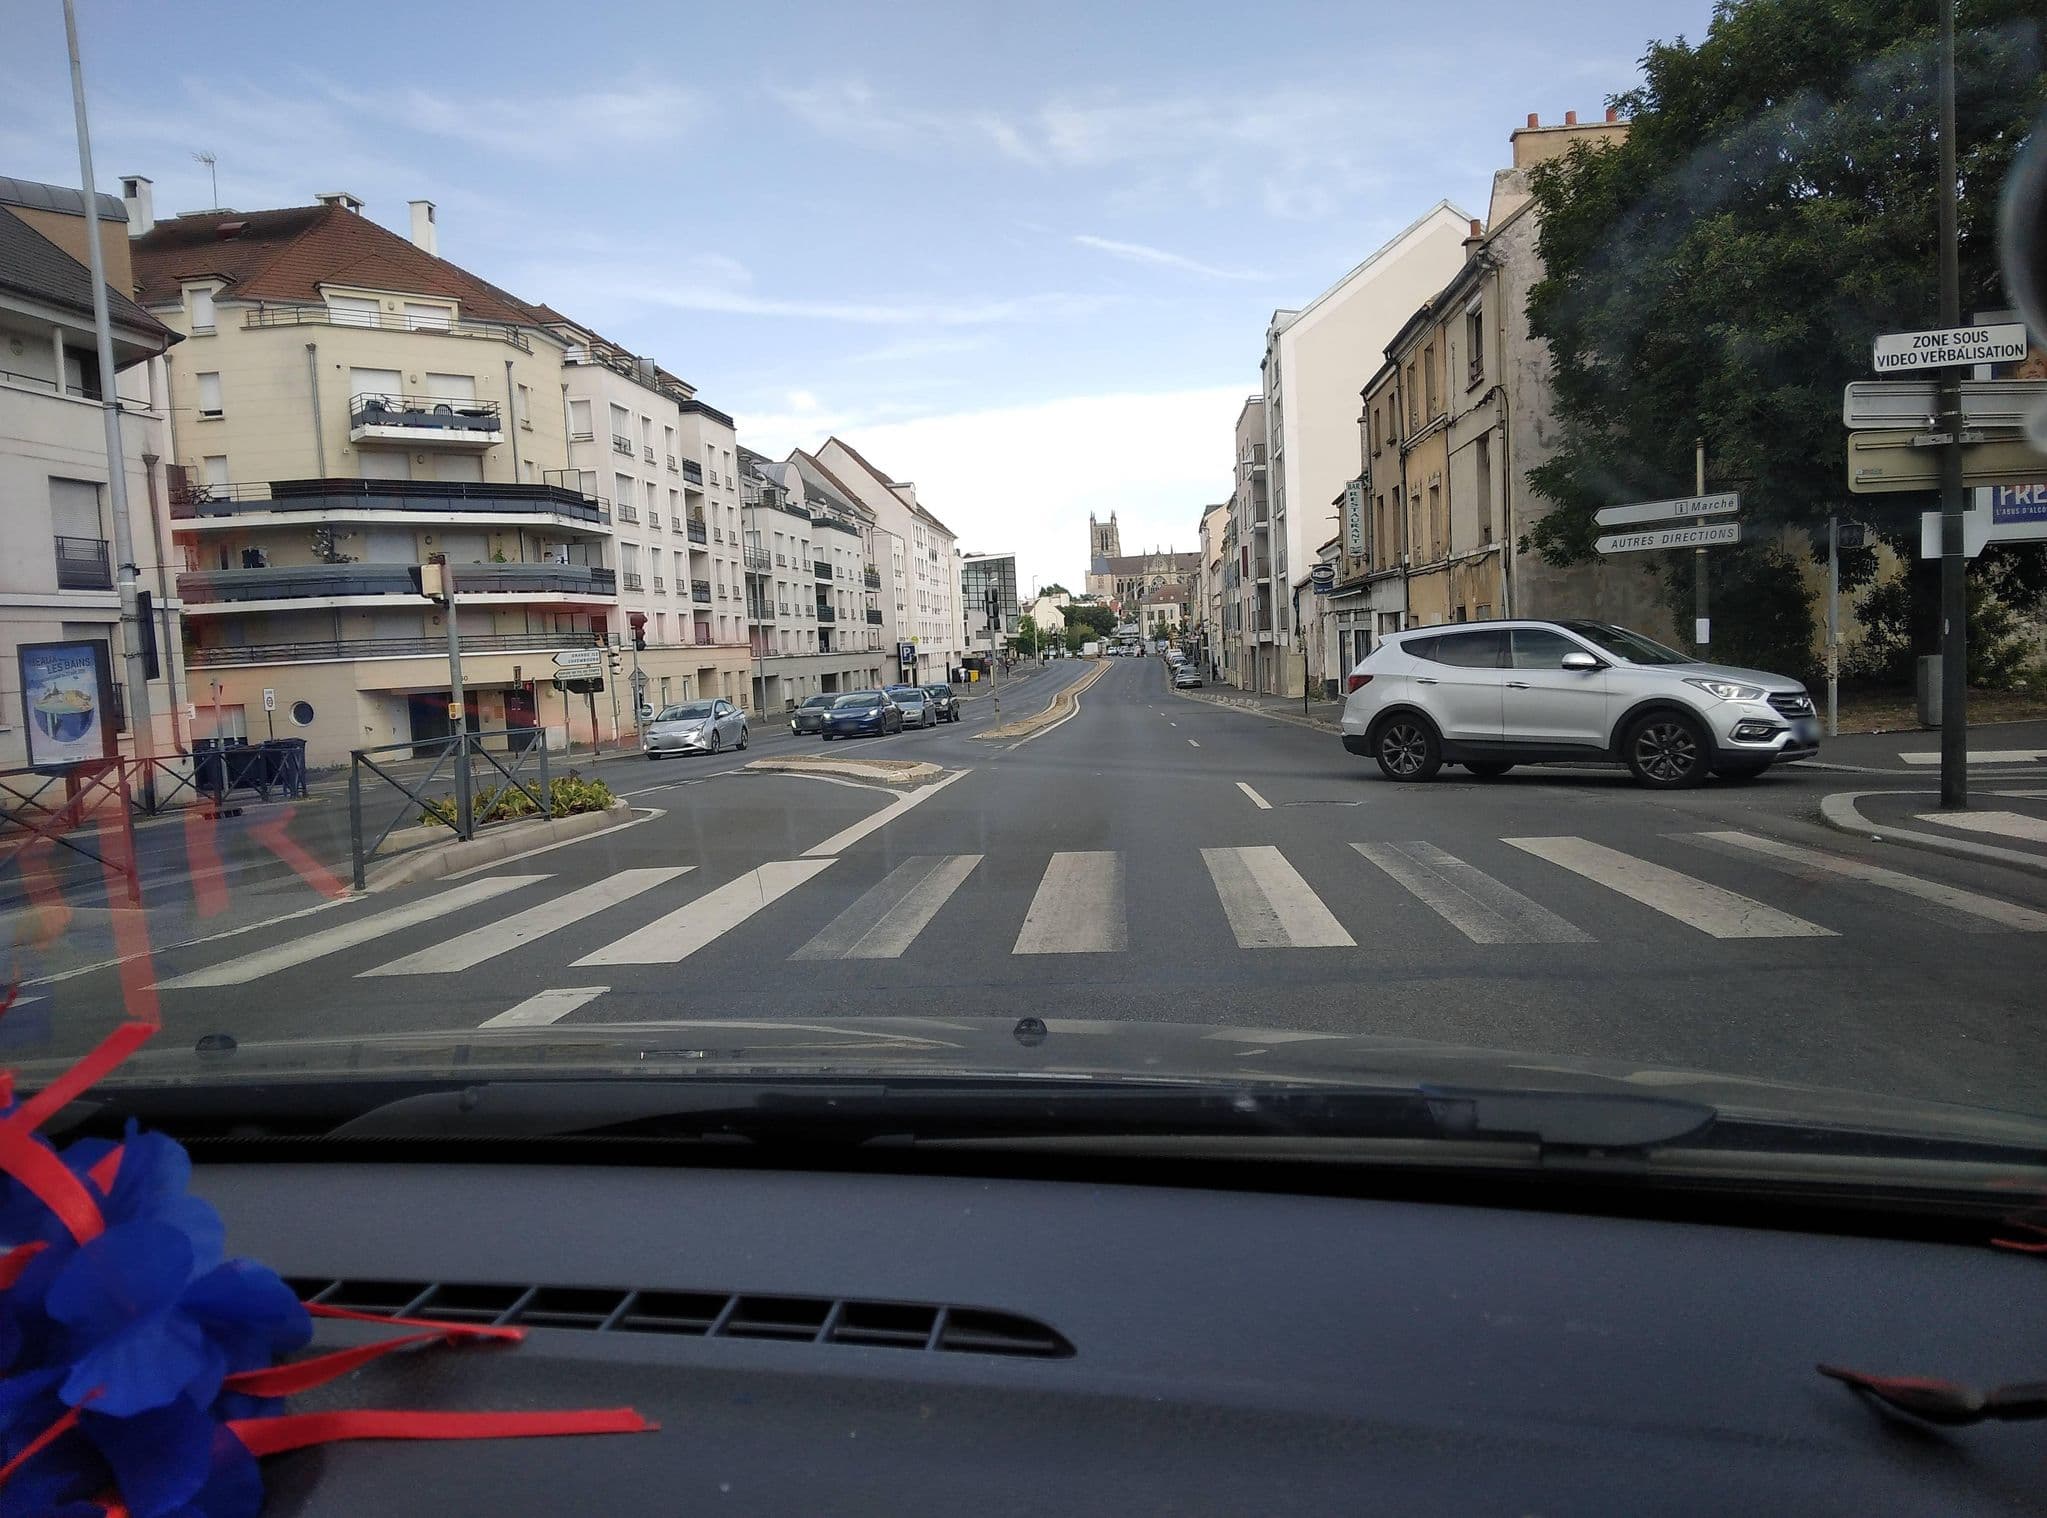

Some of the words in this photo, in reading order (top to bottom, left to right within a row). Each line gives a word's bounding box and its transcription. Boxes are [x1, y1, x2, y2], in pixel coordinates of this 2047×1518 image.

[1912, 333, 1949, 349] ZONE
[1953, 331, 1989, 345] SOUS
[1876, 352, 1918, 367] VIDEO
[1920, 344, 2024, 364] VERBALISATION
[1691, 498, 1735, 512] Marché
[1349, 491, 1360, 544] RESTAURANT
[1611, 536, 1654, 549] AUTRES
[1662, 528, 1735, 544] DIRECTIONS
[47, 662, 63, 675] LES
[64, 658, 91, 670] BAINS
